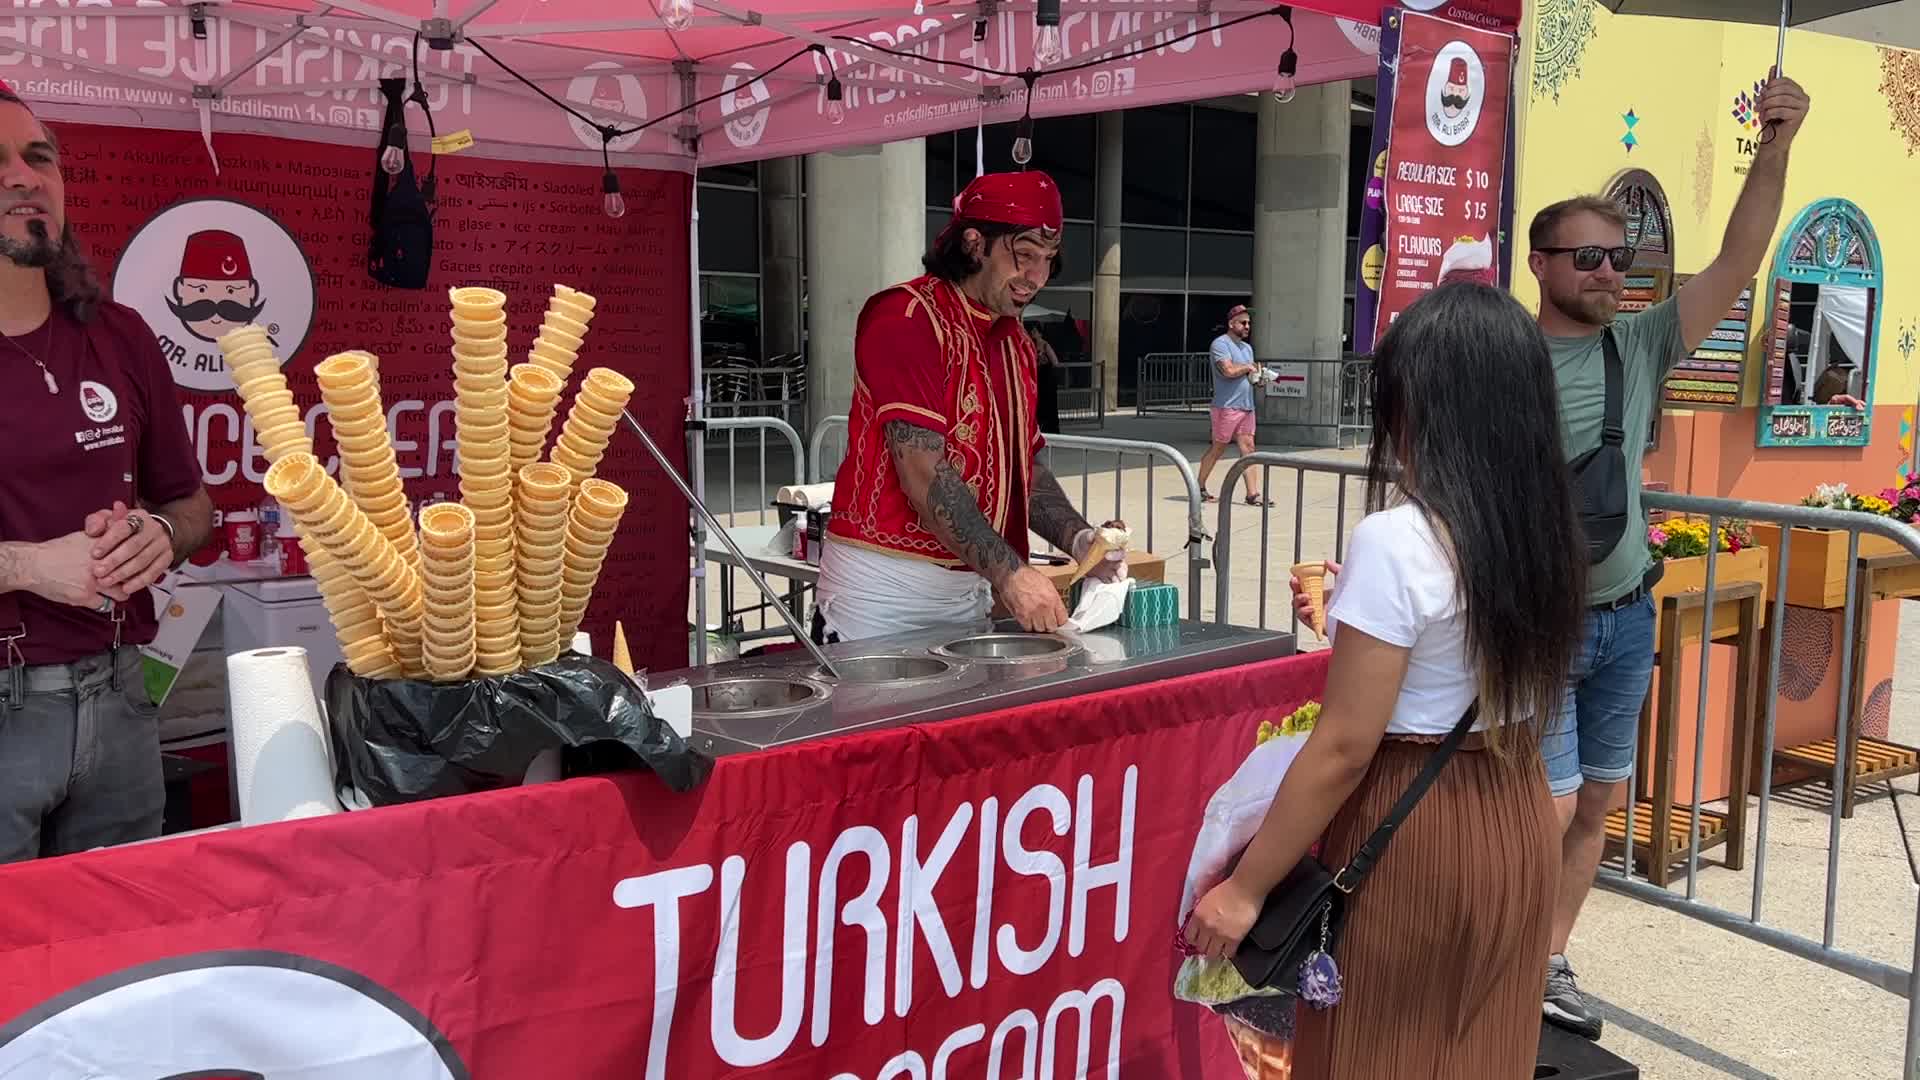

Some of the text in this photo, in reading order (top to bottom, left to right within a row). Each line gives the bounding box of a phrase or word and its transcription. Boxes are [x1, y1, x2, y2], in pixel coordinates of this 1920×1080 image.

[1397, 161, 1436, 185] REGULAR
[1436, 167, 1457, 186] SIZE
[1395, 193, 1424, 213] LARGE
[1425, 197, 1444, 216] SIZE
[72, 222, 118, 233] ream
[503, 240, 609, 256] アイスクリーム
[1399, 234, 1442, 256] FLAVOURS
[157, 334, 188, 367] MR.
[1286, 386, 1302, 396] Way
[612, 763, 1139, 1080] TURKISH
